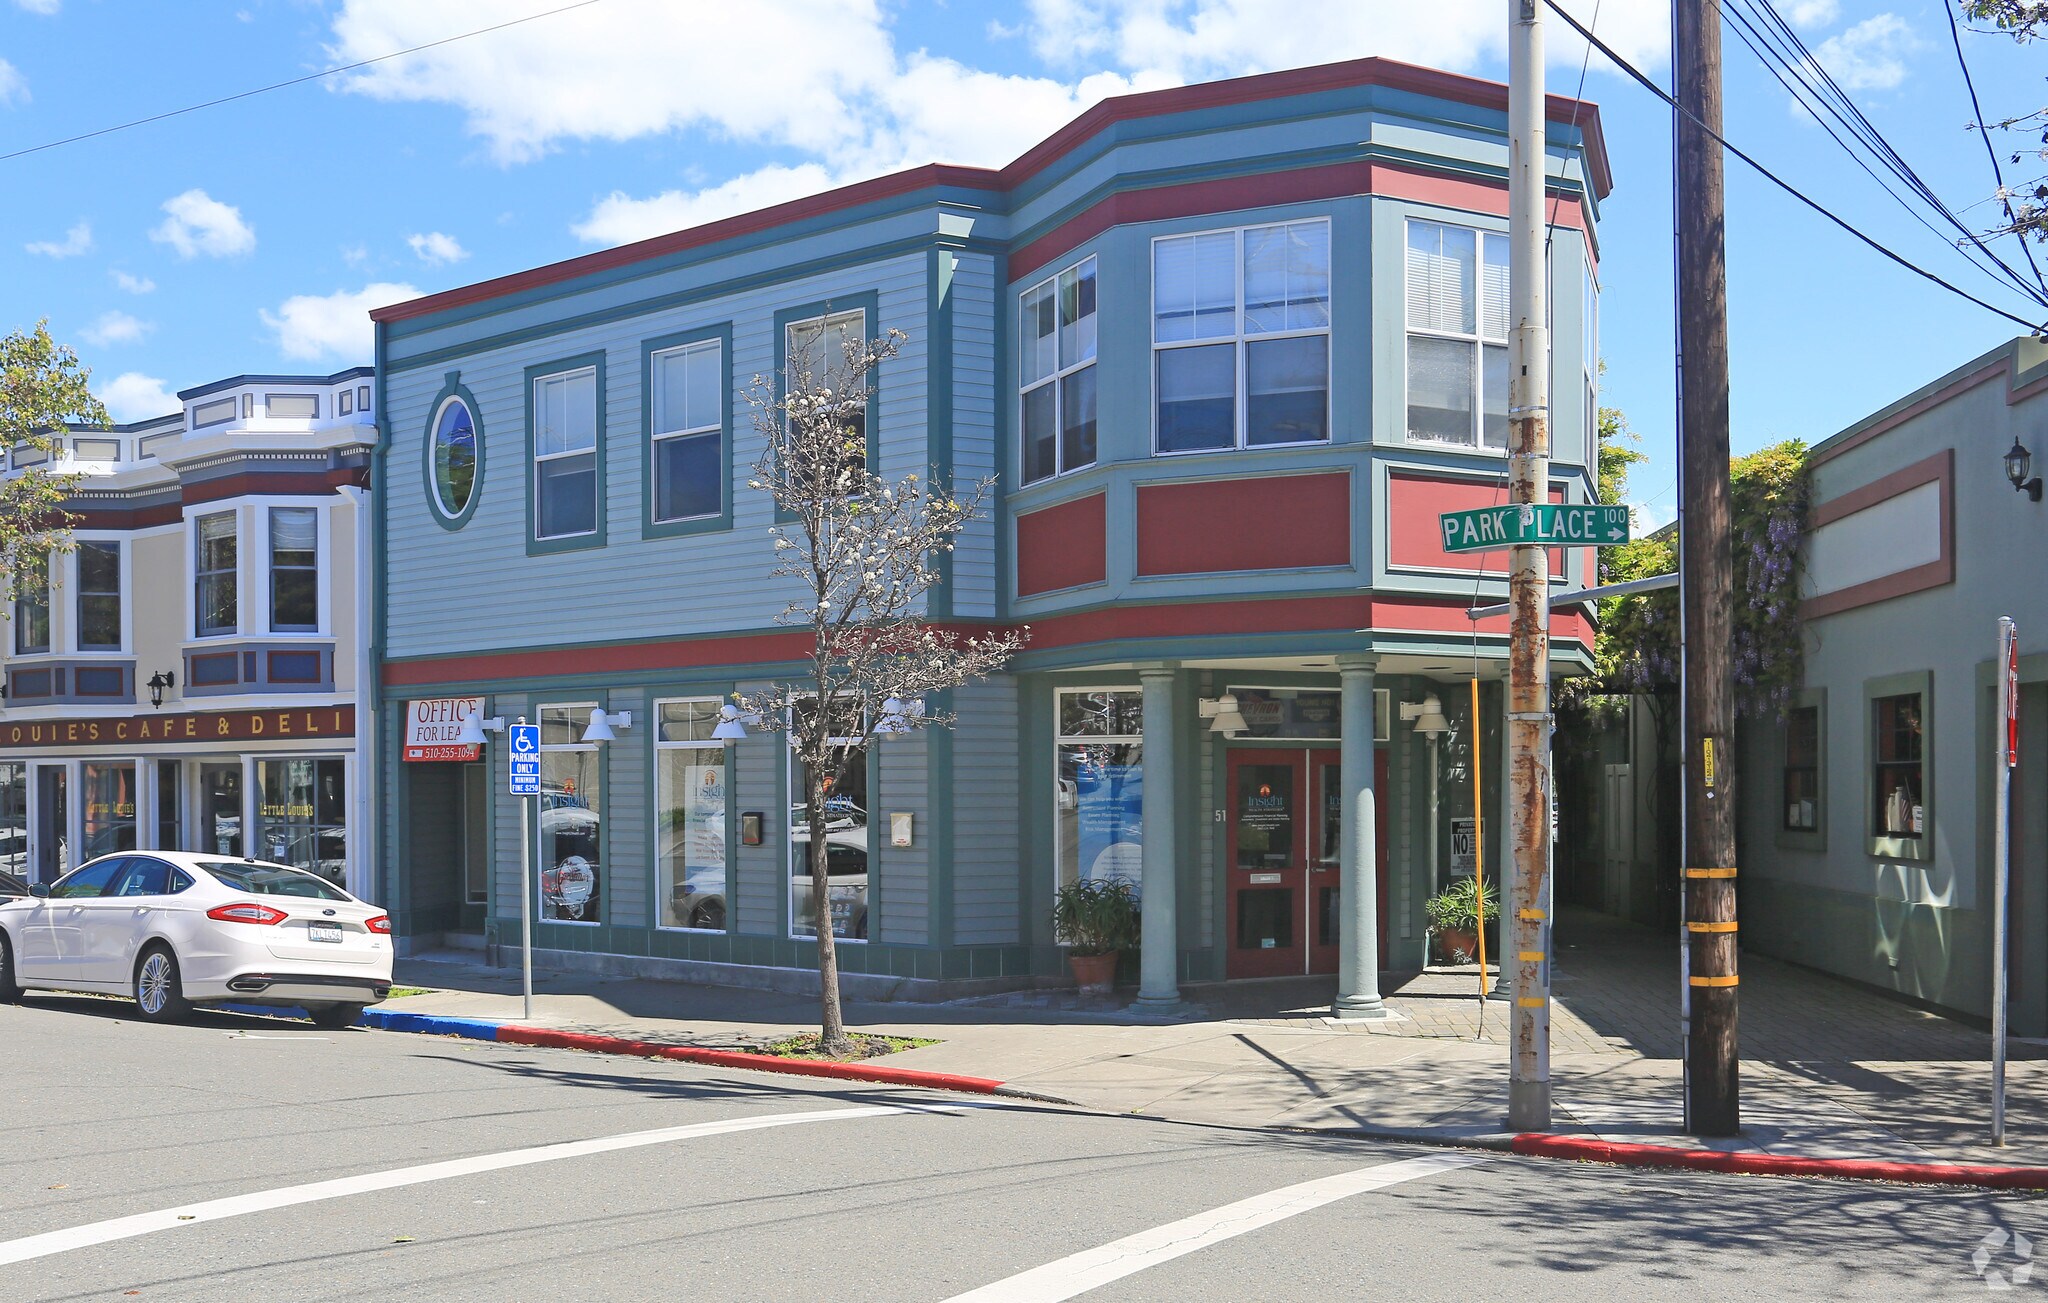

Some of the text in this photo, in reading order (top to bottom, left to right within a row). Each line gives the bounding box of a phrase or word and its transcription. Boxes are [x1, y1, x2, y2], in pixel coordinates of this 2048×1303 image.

[1444, 509, 1626, 546] PARK PLACE 100
[417, 699, 477, 723] OFFICE
[1, 711, 340, 743] OUIE'S CAFE & DELI
[416, 725, 461, 742] FOR LEA
[511, 752, 539, 763] PARKING
[516, 763, 534, 774] ONLY
[514, 776, 536, 784] MINIMUM
[512, 784, 539, 792] FINE $250
[692, 783, 726, 801] Insigh
[1248, 795, 1283, 807] Insight
[260, 802, 314, 817] LITTLE LOUIE'S
[1215, 809, 1226, 822] 51
[1453, 834, 1469, 855] NO
